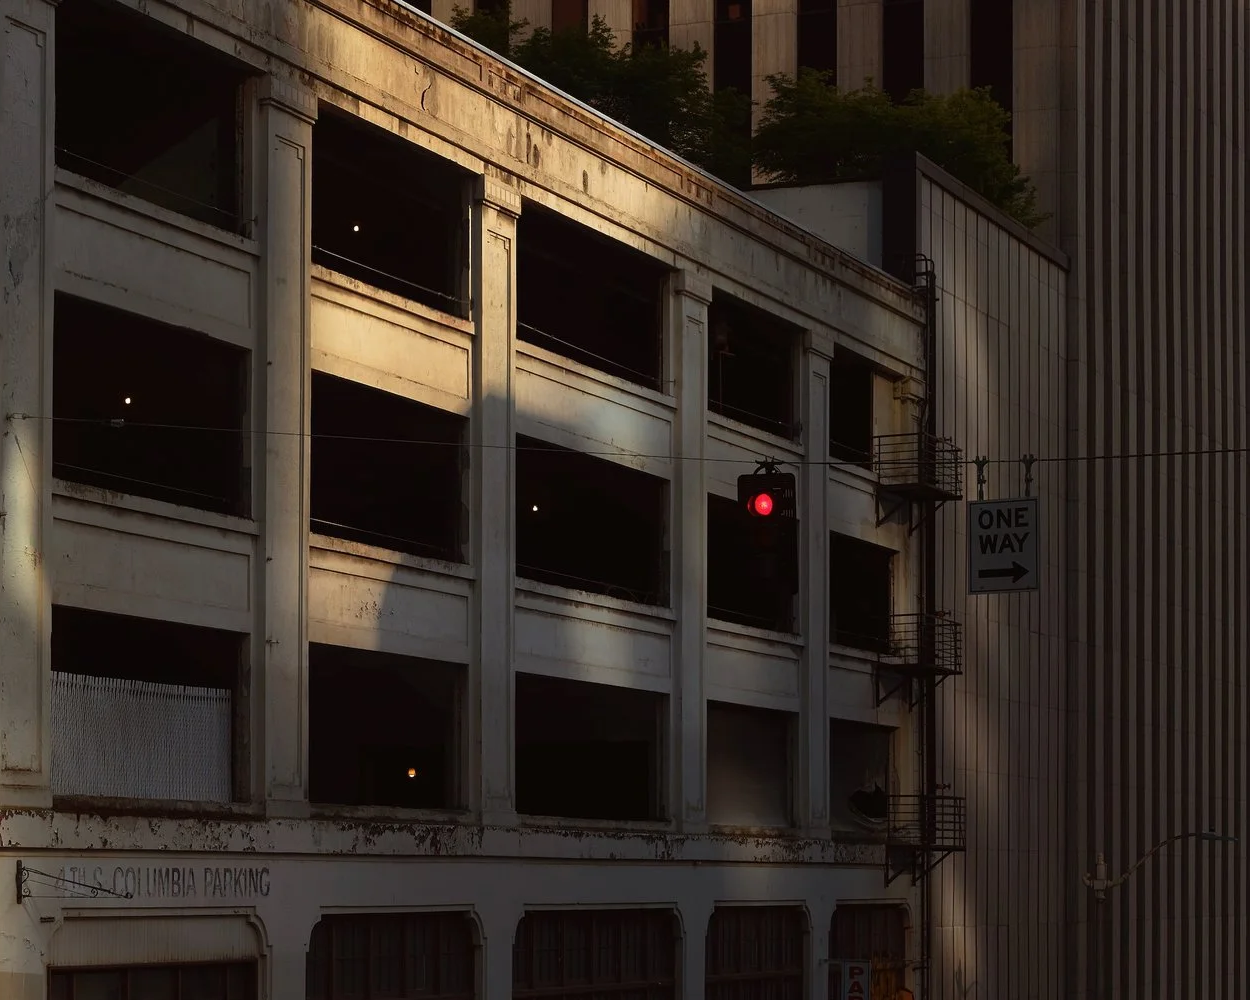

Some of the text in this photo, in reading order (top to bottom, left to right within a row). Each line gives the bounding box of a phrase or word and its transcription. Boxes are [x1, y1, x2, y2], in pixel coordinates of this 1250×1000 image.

[978, 507, 1029, 530] ONE
[978, 532, 1030, 555] WAY
[112, 866, 197, 898] COLUMBIA
[203, 867, 270, 897] PARKING
